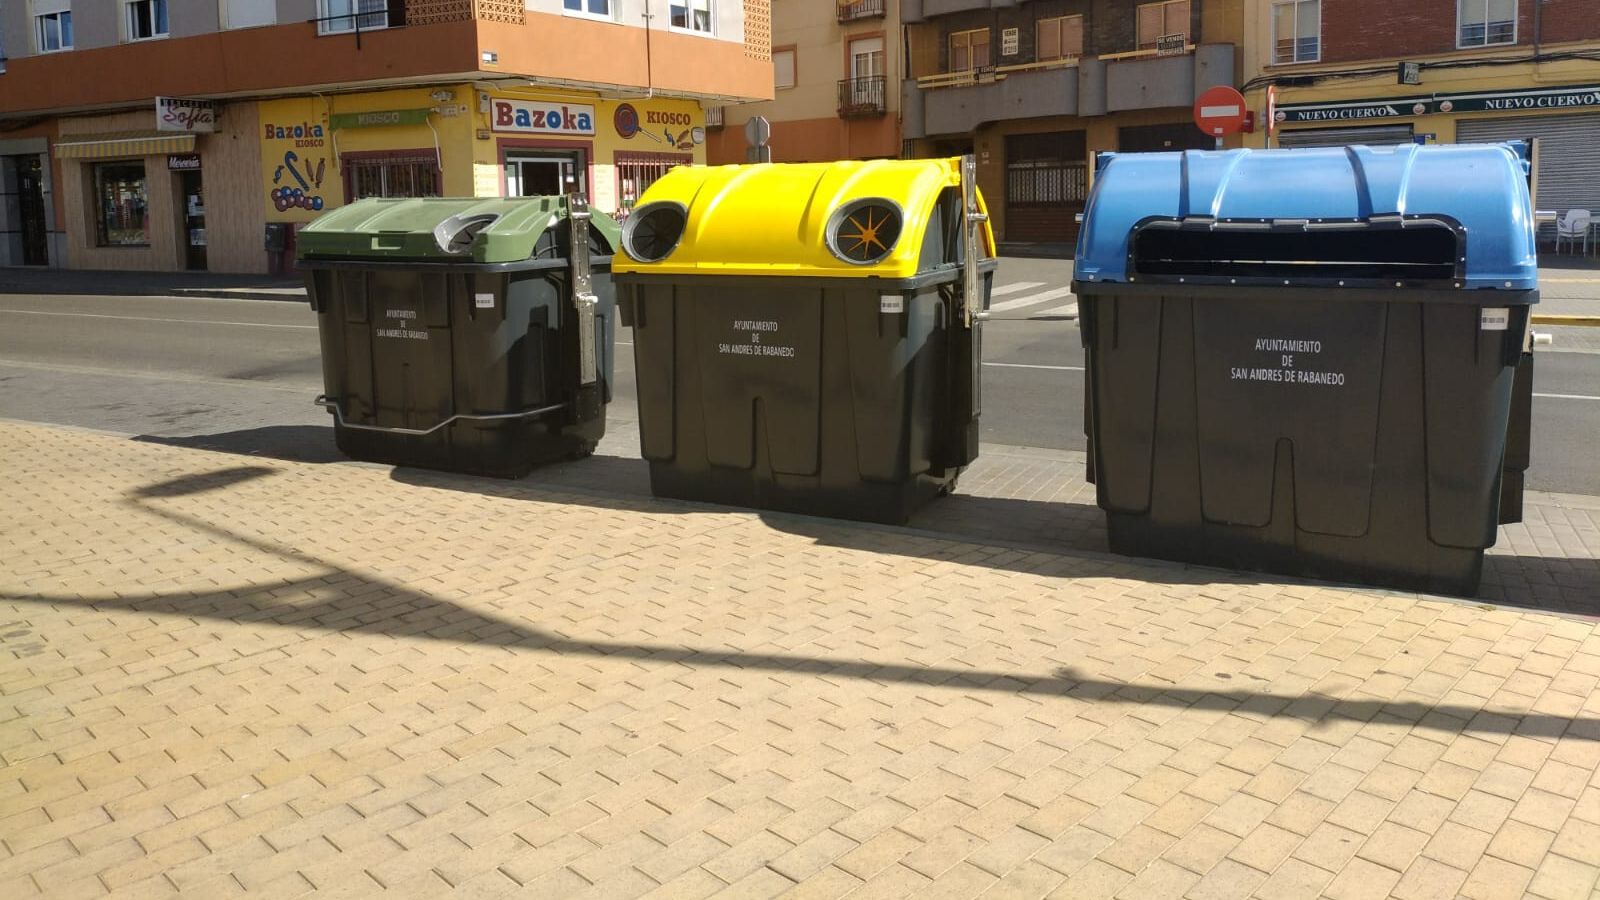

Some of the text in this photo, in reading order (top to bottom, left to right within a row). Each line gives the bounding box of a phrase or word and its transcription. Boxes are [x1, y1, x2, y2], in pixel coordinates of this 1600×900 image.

[1485, 94, 1595, 109] NUEVO CUERVO
[358, 112, 400, 125] KIOSCO
[496, 102, 592, 131] Bazoka
[647, 111, 691, 126] KIOSCO
[1298, 107, 1387, 120] NUEVO CUERVO
[265, 121, 324, 139] Bazoka
[295, 139, 324, 148] KIOSCO
[386, 309, 417, 319] AYUNTAMIENTO
[734, 320, 778, 332] AYUNTAMIENTO
[376, 328, 385, 336] SAN
[402, 330, 408, 338] DE
[752, 333, 760, 343] DE
[719, 343, 794, 357] SAN ANDRES DE RABANEDO
[1255, 338, 1321, 353] AYUNTAMIENTO
[1282, 355, 1293, 367] DE
[1231, 367, 1345, 385] SAN ANDRES DE RABANEDO
